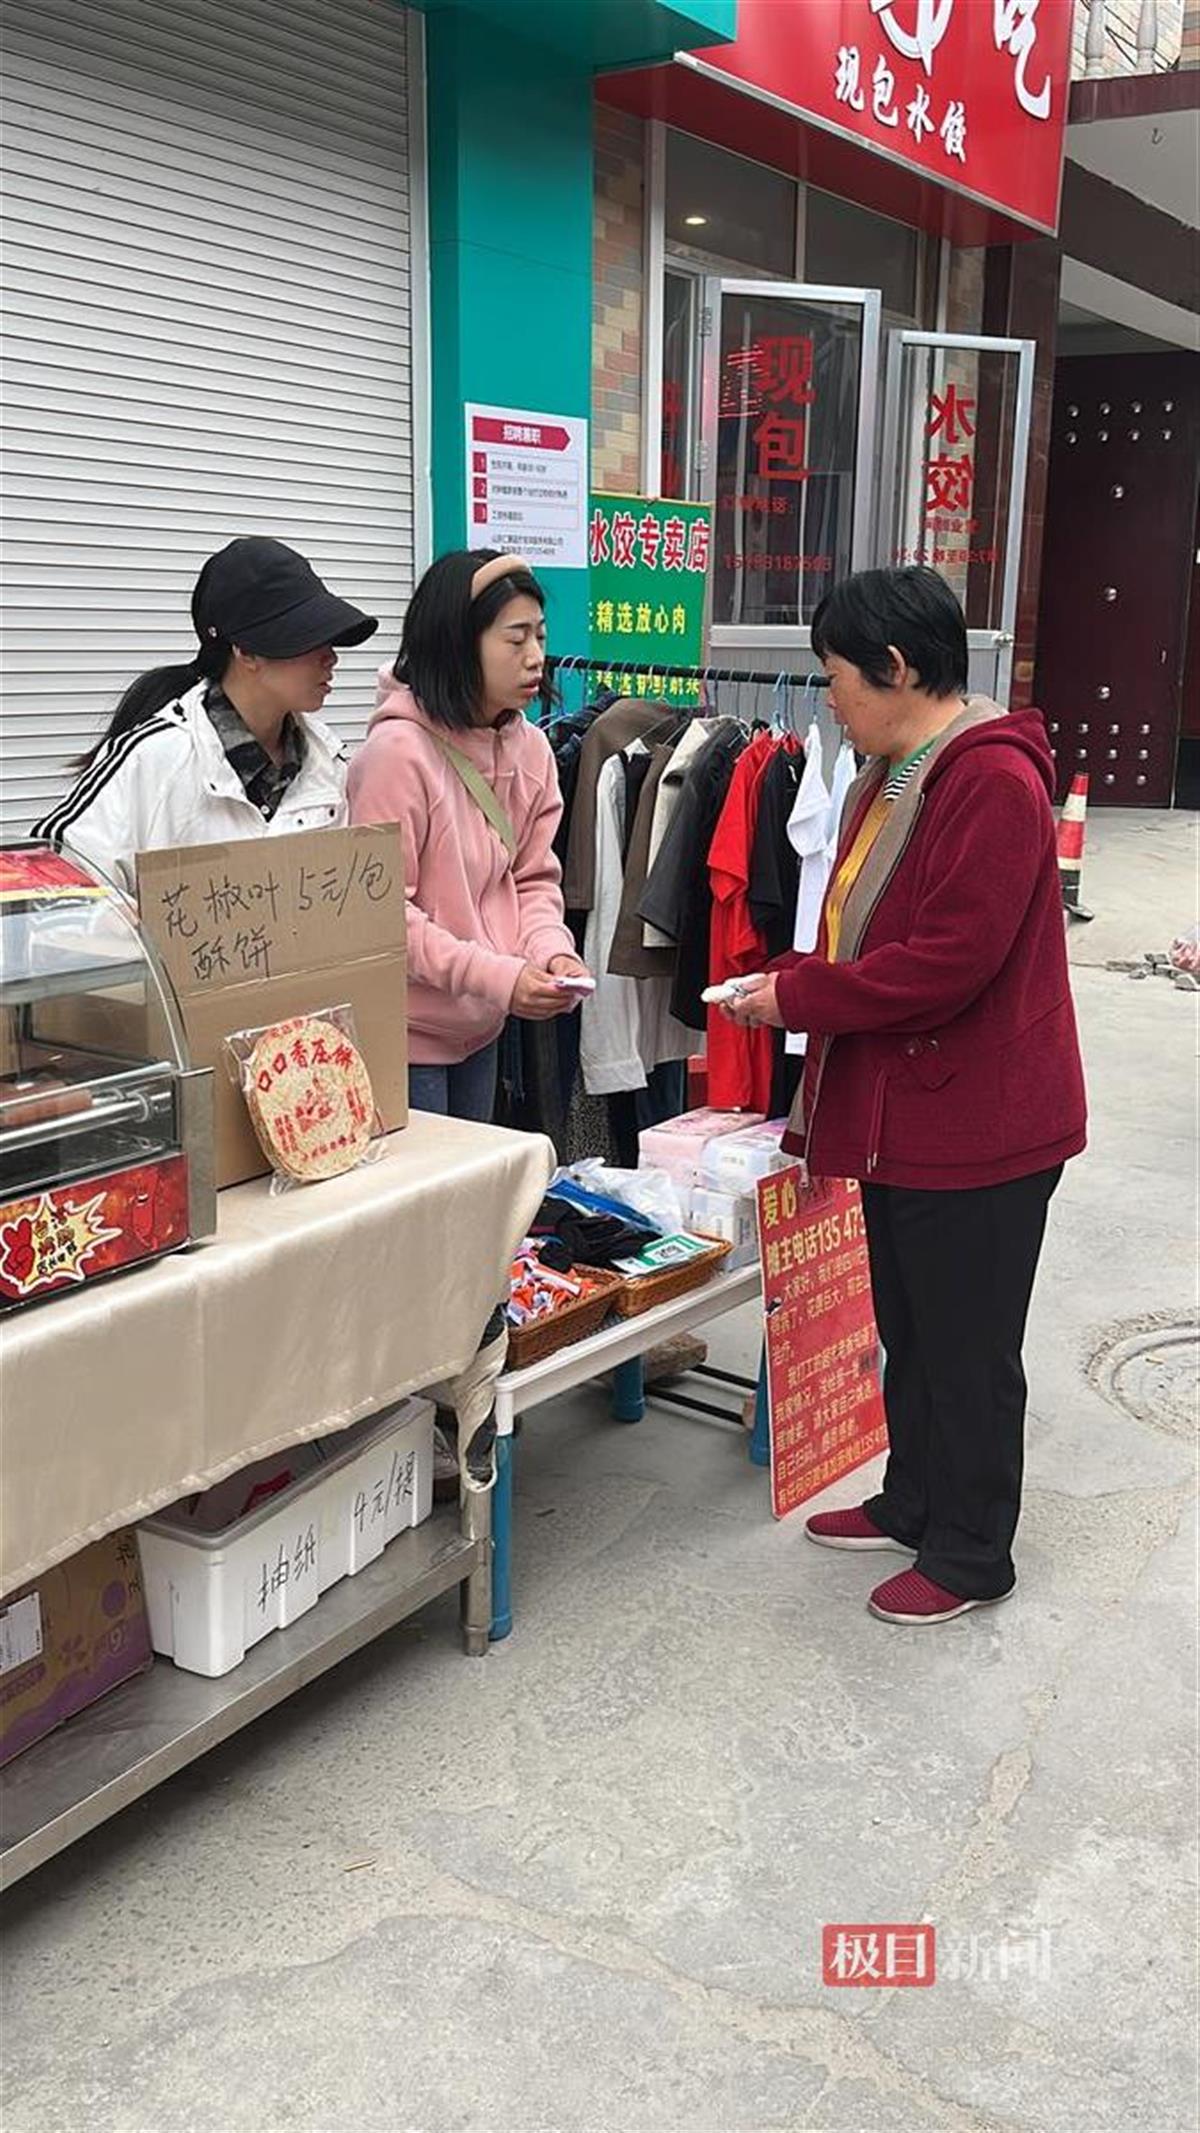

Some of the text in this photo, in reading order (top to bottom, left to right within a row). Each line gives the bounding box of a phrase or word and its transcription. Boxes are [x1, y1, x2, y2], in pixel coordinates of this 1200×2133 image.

[834, 45, 967, 163] 现包水饺
[590, 509, 711, 572] 水饺专卖店
[588, 600, 686, 634] 精选放心肉
[161, 872, 278, 938] 花椒叶
[763, 1178, 796, 1230] 爱心
